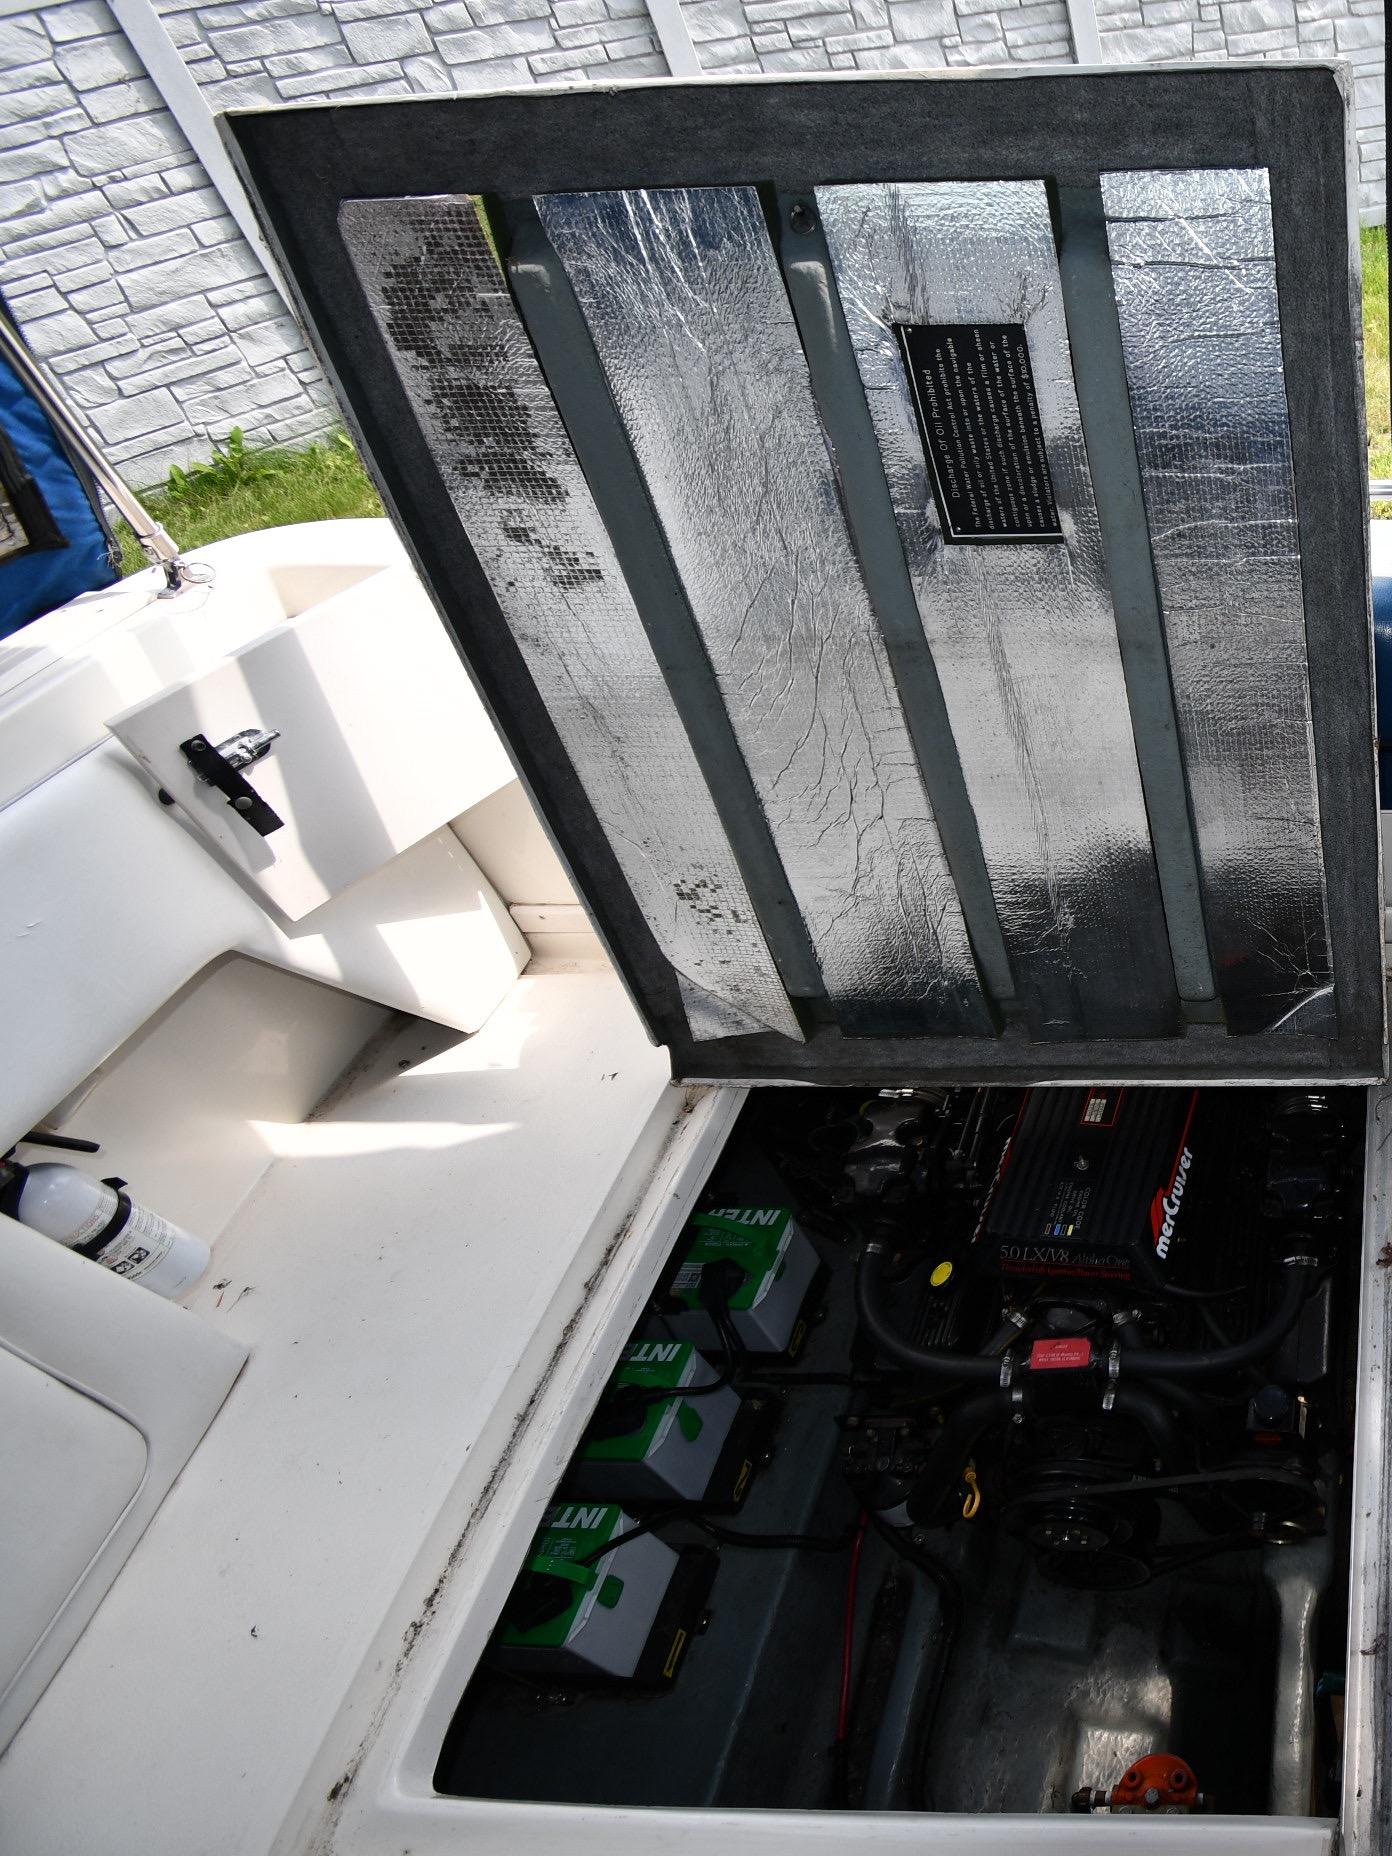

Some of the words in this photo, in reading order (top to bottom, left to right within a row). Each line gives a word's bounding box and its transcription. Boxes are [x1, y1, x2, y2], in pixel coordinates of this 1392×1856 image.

[974, 329, 982, 350] sheen
[989, 341, 996, 349] or
[946, 338, 958, 372] navigable
[979, 353, 984, 361] or
[992, 352, 1000, 372] water
[1017, 344, 1029, 378] $10,000.
[980, 364, 988, 377] film
[1007, 361, 1016, 388] surface
[922, 370, 940, 418] Prohibited
[958, 390, 966, 405] upon
[972, 387, 981, 411] waters
[986, 388, 995, 412] causes
[1027, 392, 1037, 418] penalty
[1001, 400, 1010, 426] surface
[1015, 405, 1026, 432] beneath
[934, 422, 944, 435] Oil
[948, 413, 960, 437] Control
[992, 415, 1003, 447] discharge
[938, 439, 948, 450] Of
[956, 440, 967, 468] Pollution
[983, 438, 992, 459] States
[1035, 438, 1044, 462] subject
[944, 455, 960, 497] Discharge
[964, 471, 972, 489] Water
[987, 462, 997, 482] United
[1030, 476, 1038, 496] sludge
[967, 492, 978, 515] Federal
[984, 500, 994, 529] discharge
[999, 507, 1007, 527] waters
[1036, 506, 1044, 527] causes
